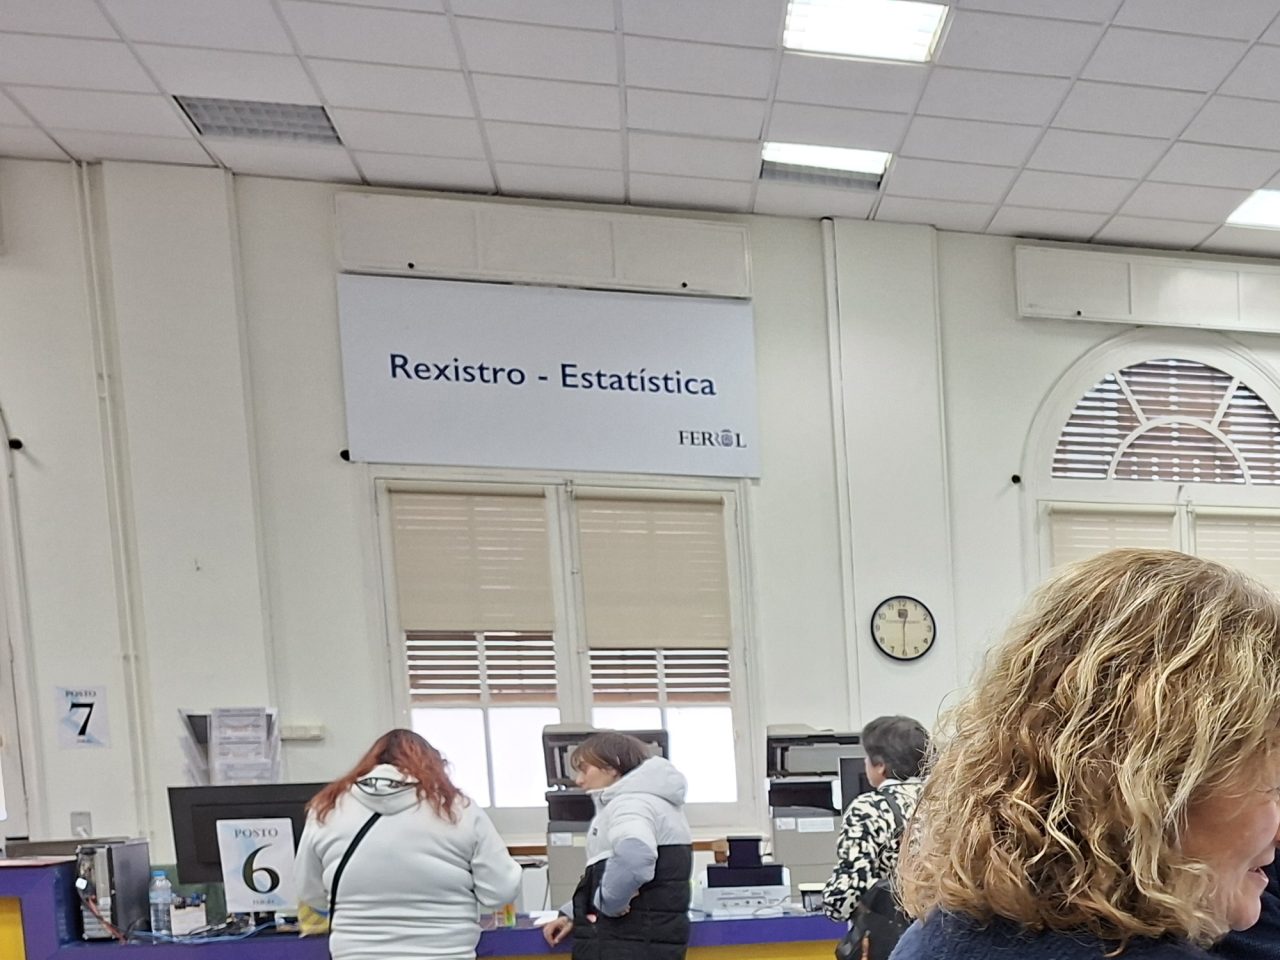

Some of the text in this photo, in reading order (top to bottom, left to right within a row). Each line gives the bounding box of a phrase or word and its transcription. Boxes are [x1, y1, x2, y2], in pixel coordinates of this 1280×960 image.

[390, 353, 525, 385] Rexistro
[560, 363, 717, 396] Estatística
[69, 702, 95, 736] 7
[234, 827, 279, 839] POSTO
[242, 843, 280, 894] 6
